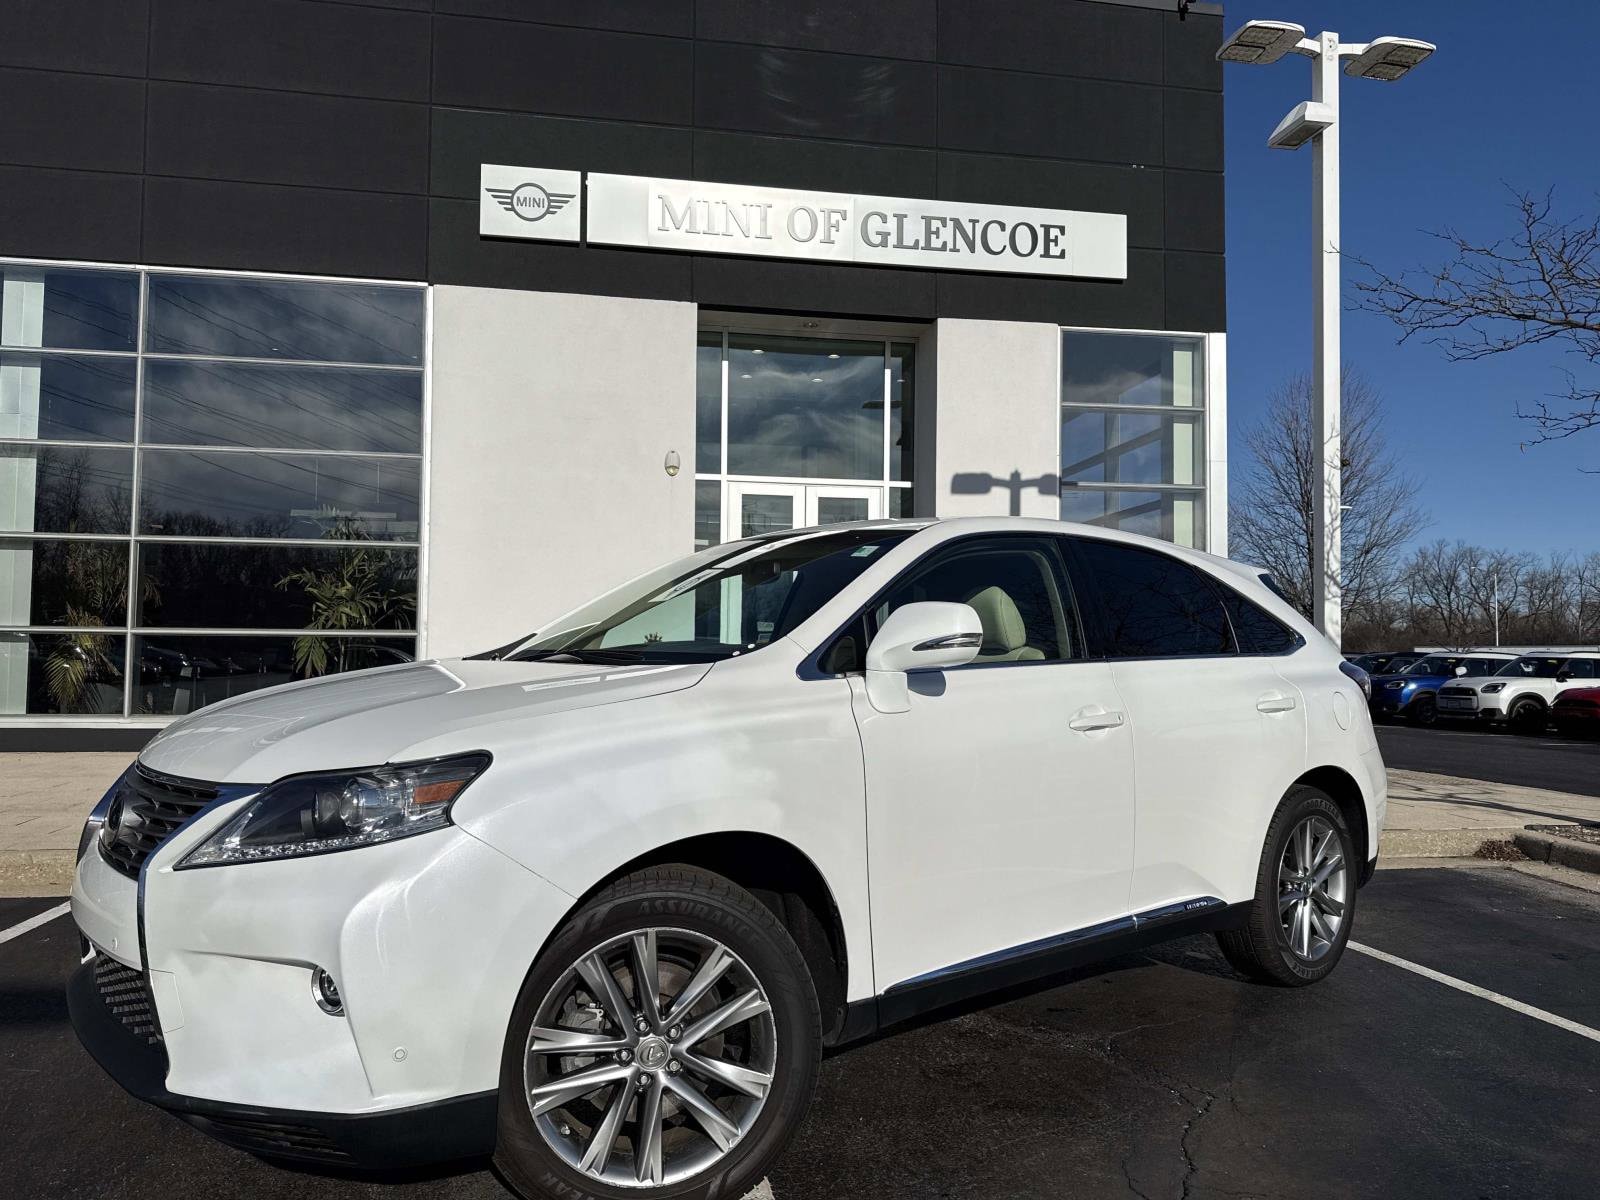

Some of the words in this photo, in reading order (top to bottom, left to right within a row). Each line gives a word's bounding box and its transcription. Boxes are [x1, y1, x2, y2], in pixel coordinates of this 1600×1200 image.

[516, 196, 545, 209] MINI
[657, 194, 773, 240] MINI
[786, 205, 847, 245] OF
[860, 210, 1066, 260] GLENCOE
